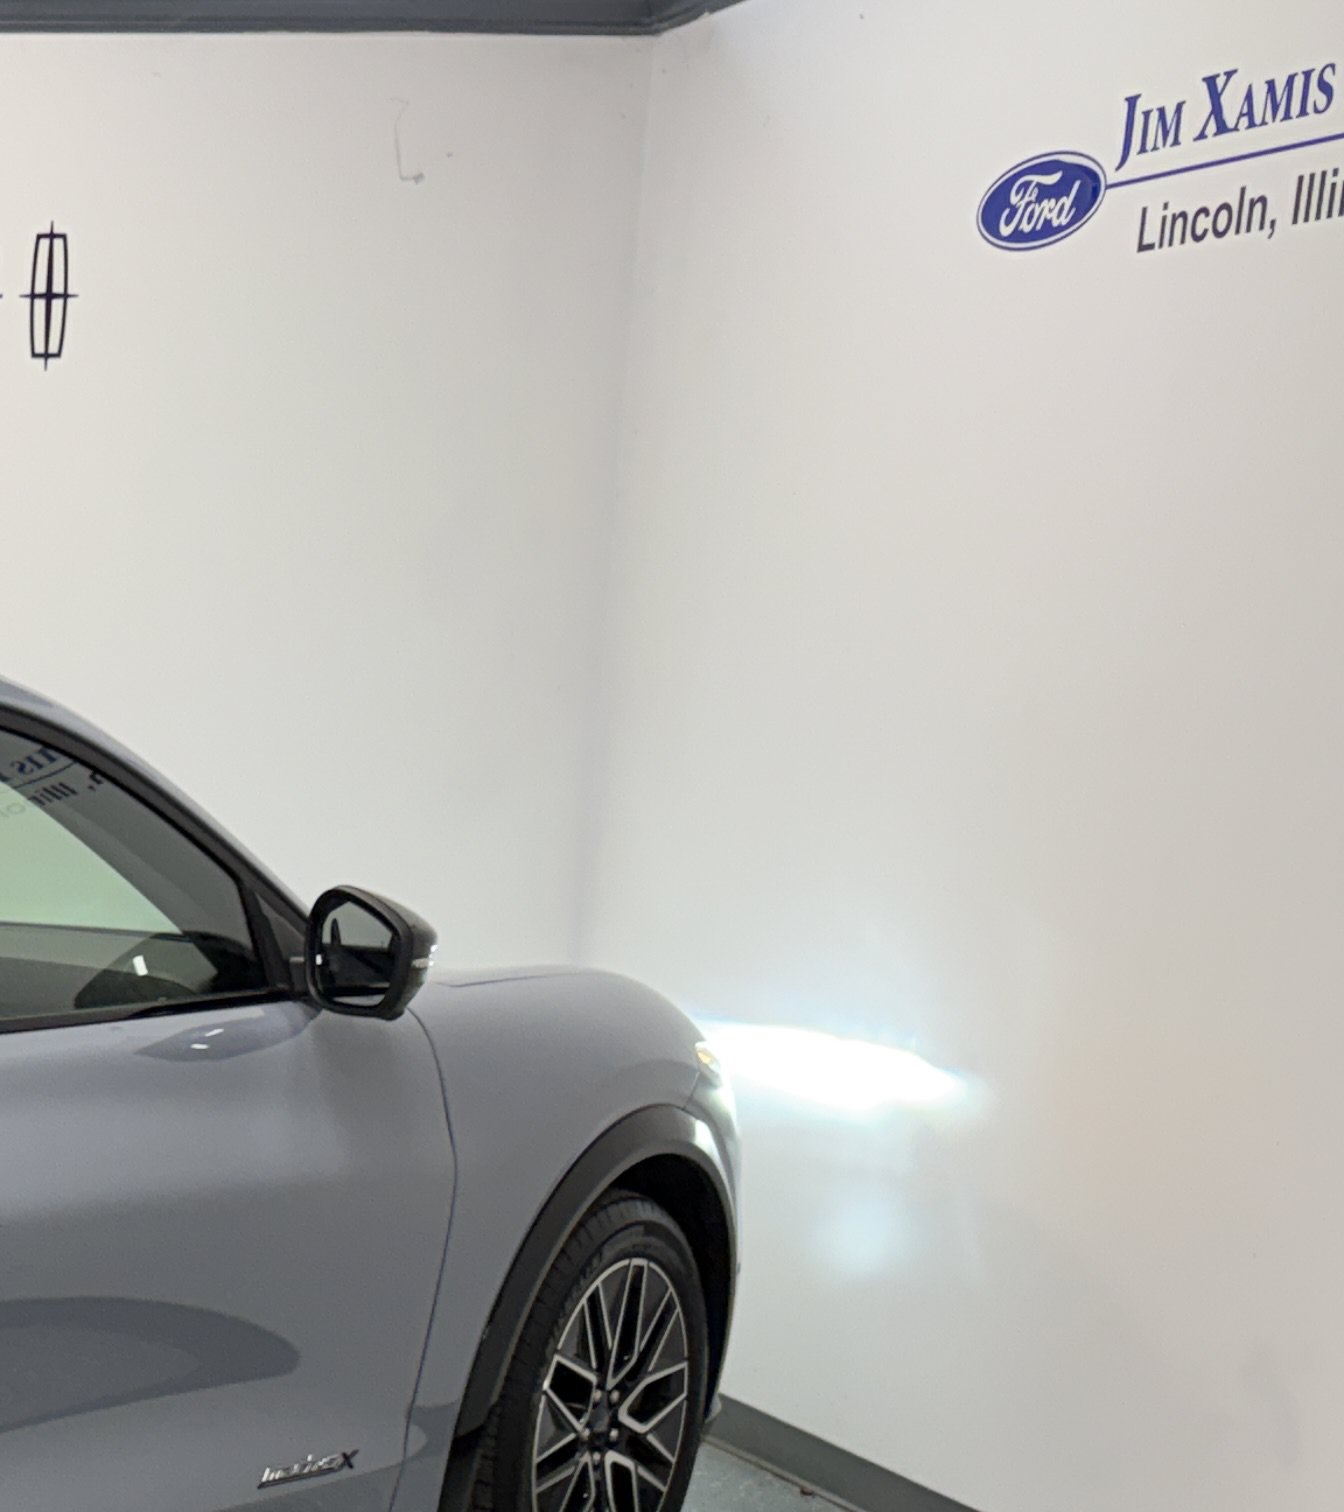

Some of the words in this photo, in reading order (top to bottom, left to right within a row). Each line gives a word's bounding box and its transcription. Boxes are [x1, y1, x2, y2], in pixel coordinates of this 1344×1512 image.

[1115, 93, 1186, 172] JIM
[1193, 62, 1336, 142] XAMIS
[999, 170, 1081, 237] Ford
[1136, 185, 1276, 253] Lincoln,
